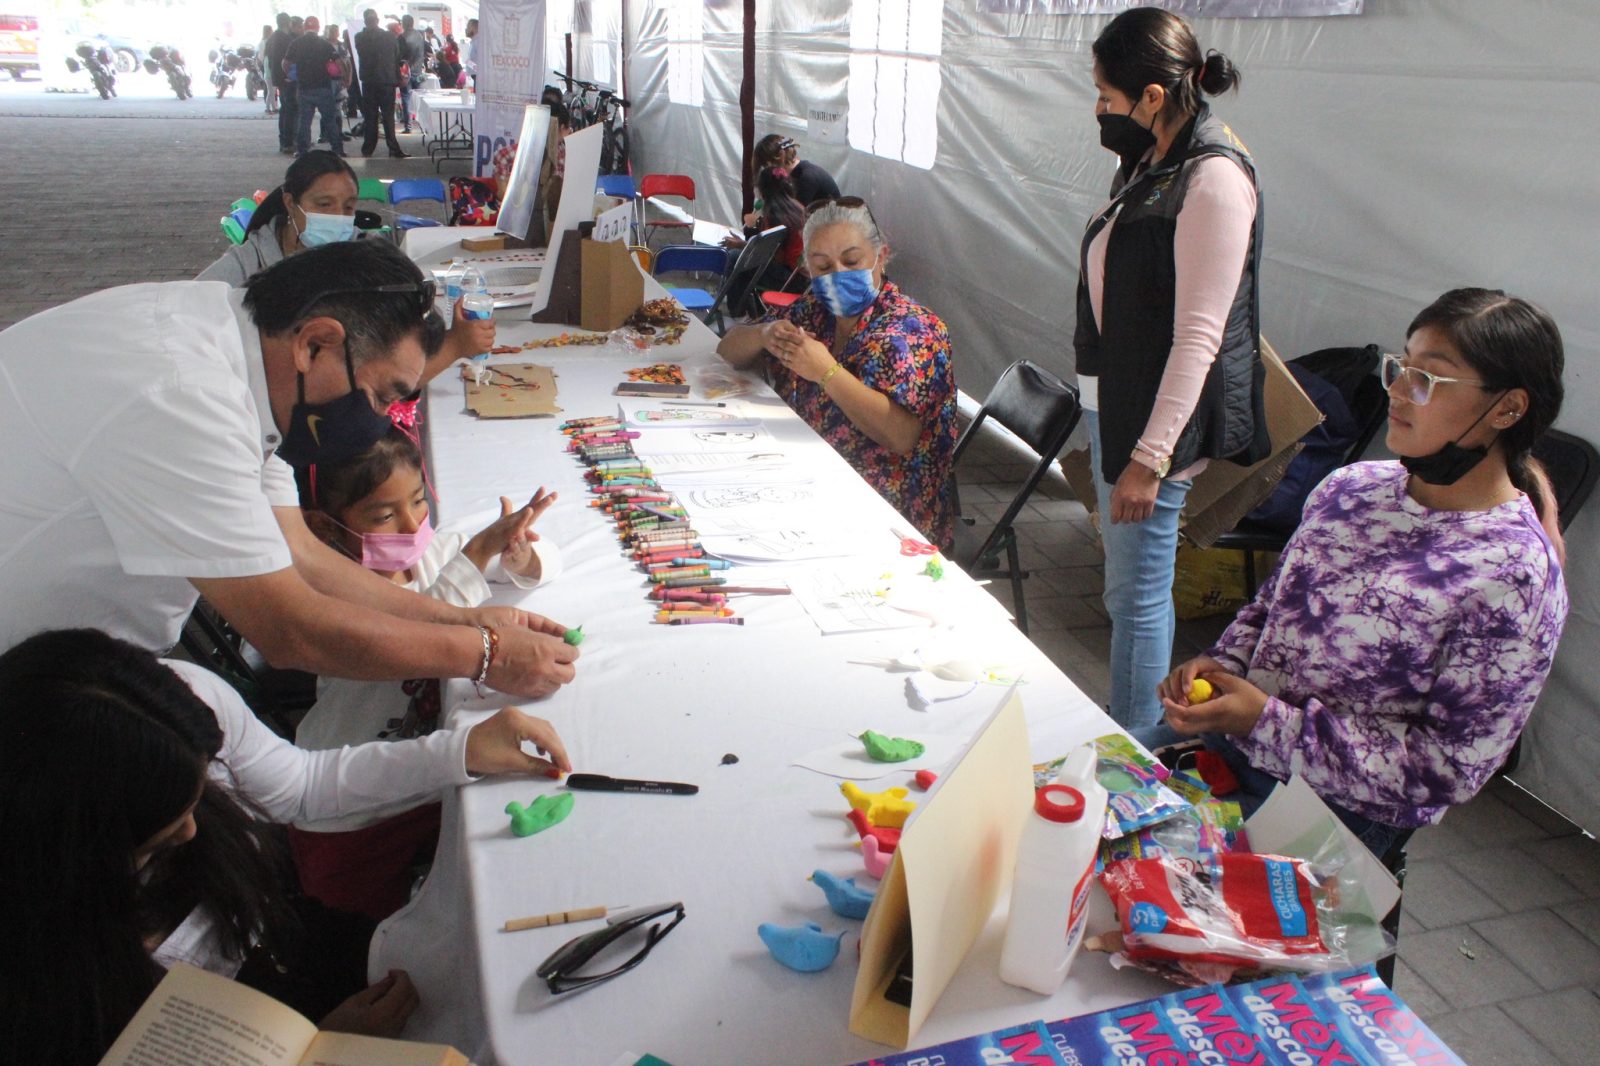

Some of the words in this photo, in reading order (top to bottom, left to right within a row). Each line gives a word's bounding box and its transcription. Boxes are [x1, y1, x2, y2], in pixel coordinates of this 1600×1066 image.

[491, 54, 530, 69] TEXCOCO
[1270, 861, 1293, 919] CUCHARAS
[1166, 1007, 1225, 1066] desc
